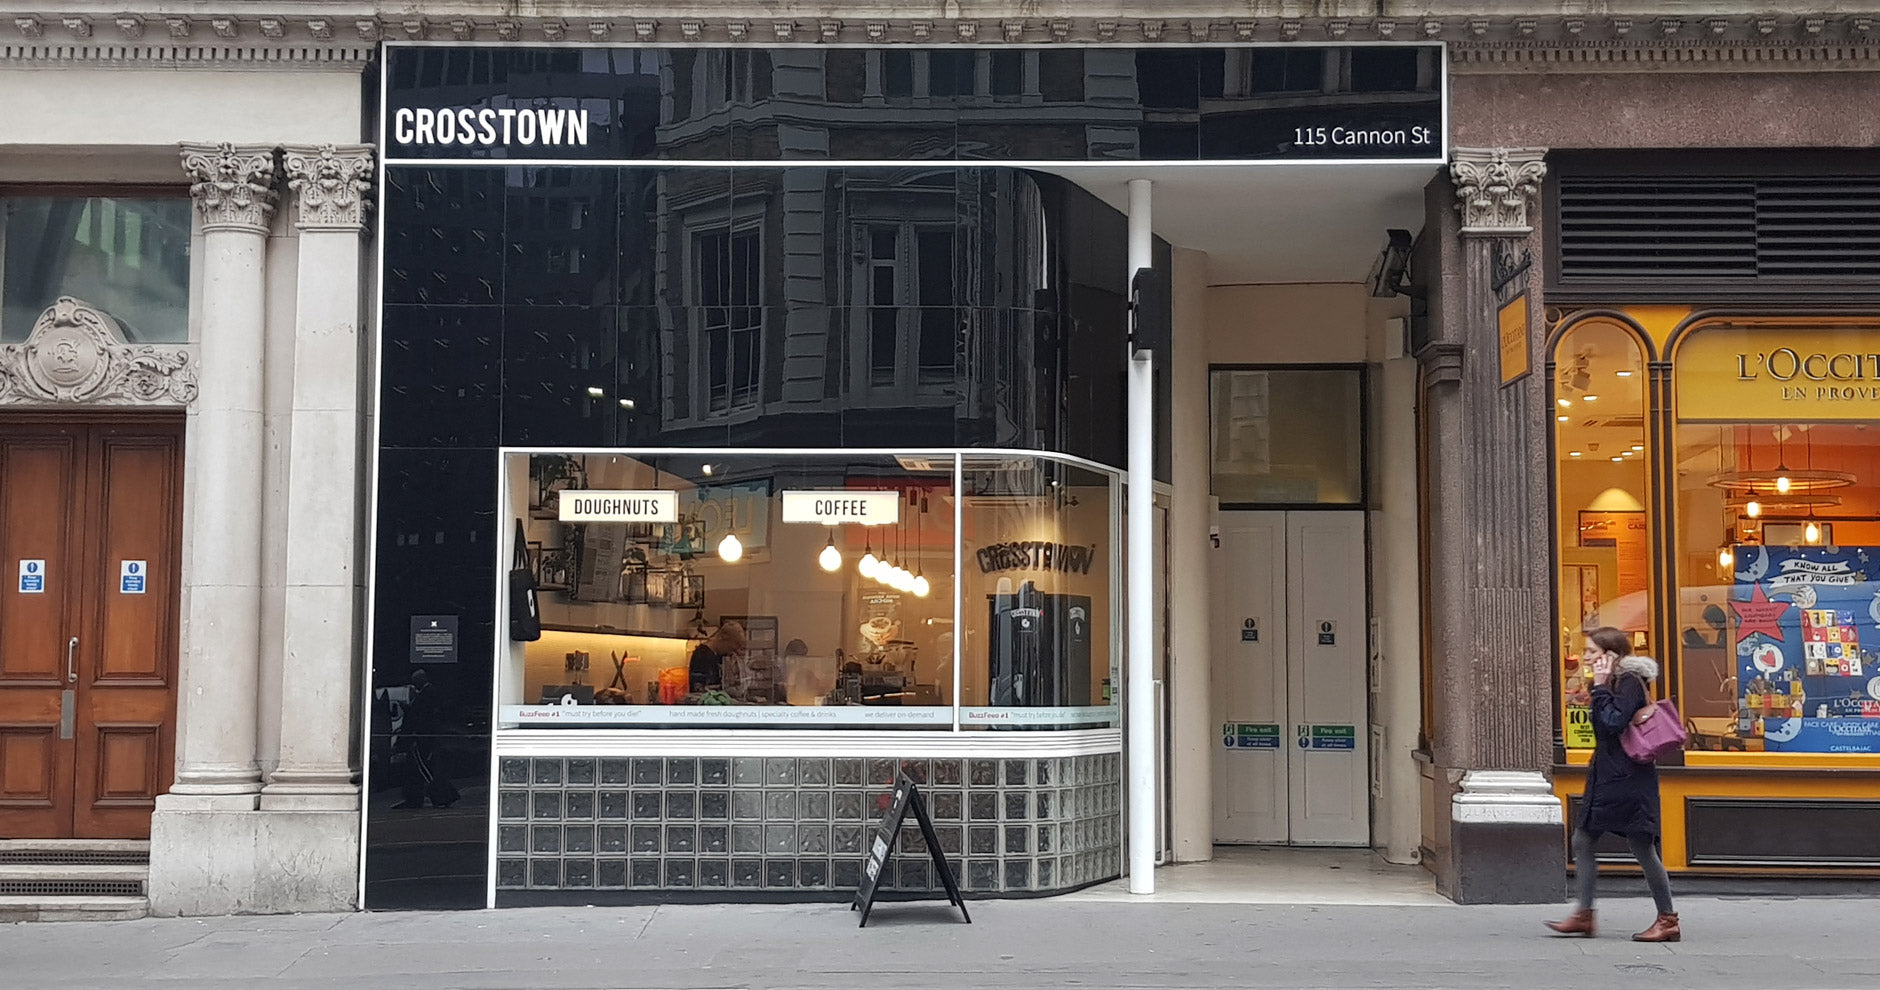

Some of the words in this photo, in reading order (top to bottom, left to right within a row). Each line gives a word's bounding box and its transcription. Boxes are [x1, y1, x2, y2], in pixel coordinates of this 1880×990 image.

[396, 108, 588, 145] CROSSTOWN
[1294, 128, 1327, 145] 115
[1331, 127, 1406, 145] Cannon
[1411, 126, 1431, 144] St
[1782, 386, 1807, 399] EN
[574, 499, 659, 515] DOUGHNUTS
[815, 499, 867, 516] COFFEE
[1794, 561, 1819, 571] KNOW
[1822, 564, 1838, 572] ALL
[1784, 575, 1806, 583] THAT
[1810, 574, 1827, 583] YOU
[1829, 575, 1849, 583] GIVE
